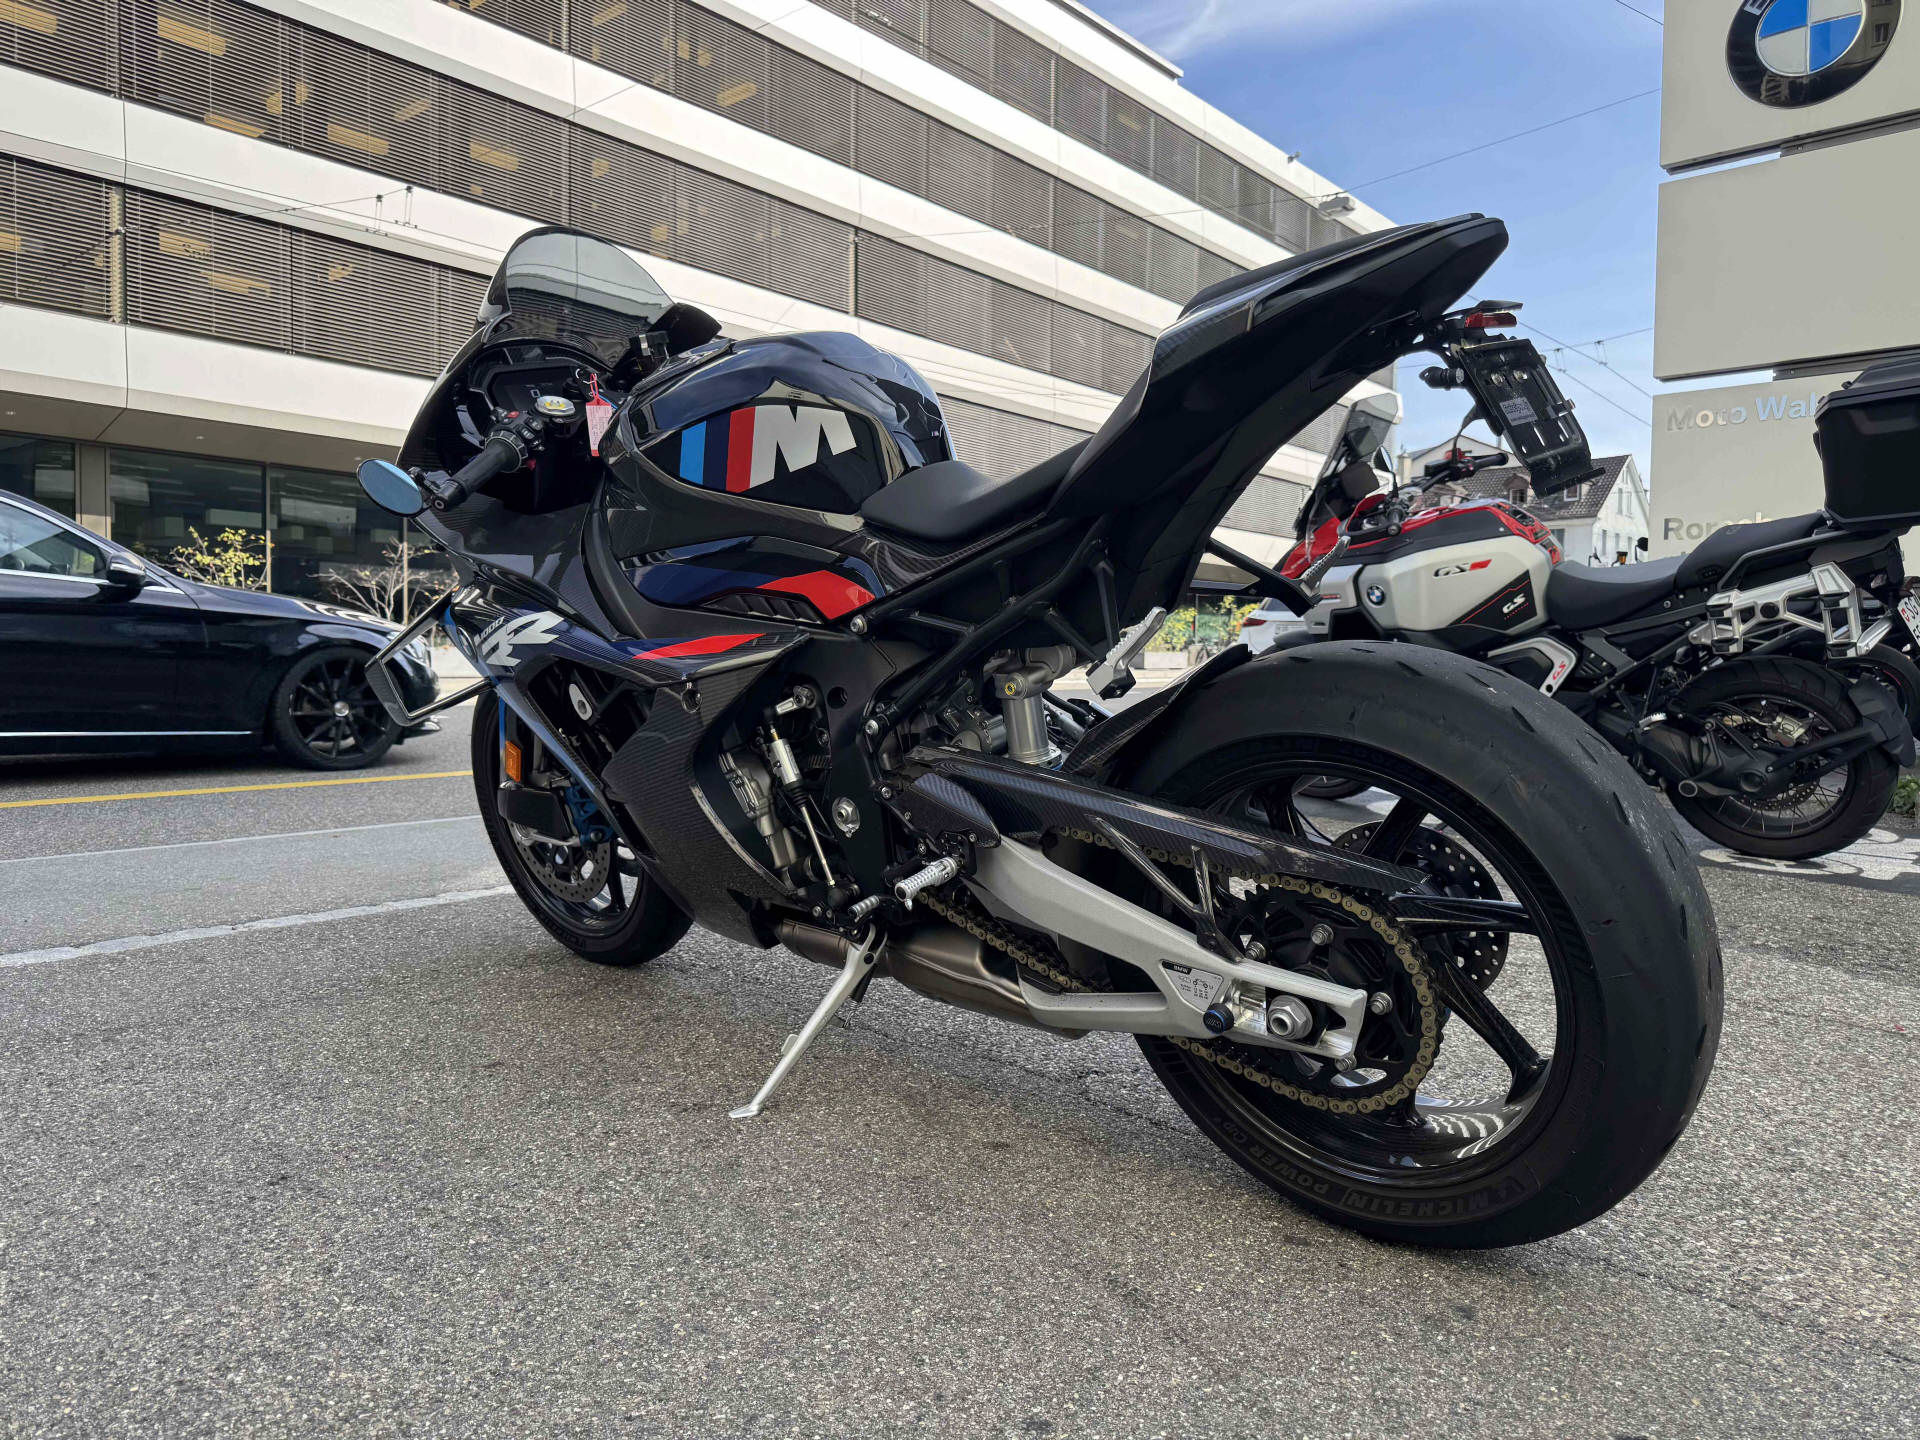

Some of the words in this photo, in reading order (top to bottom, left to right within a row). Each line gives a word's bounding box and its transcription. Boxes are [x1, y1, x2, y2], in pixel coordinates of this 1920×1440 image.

[1665, 404, 1747, 431] Moto
[1755, 391, 1816, 421] Wal
[1502, 592, 1527, 615] GS
[481, 610, 565, 667] RR
[1250, 1143, 1329, 1194] POWER
[1348, 1188, 1490, 1217] MICHELIN
